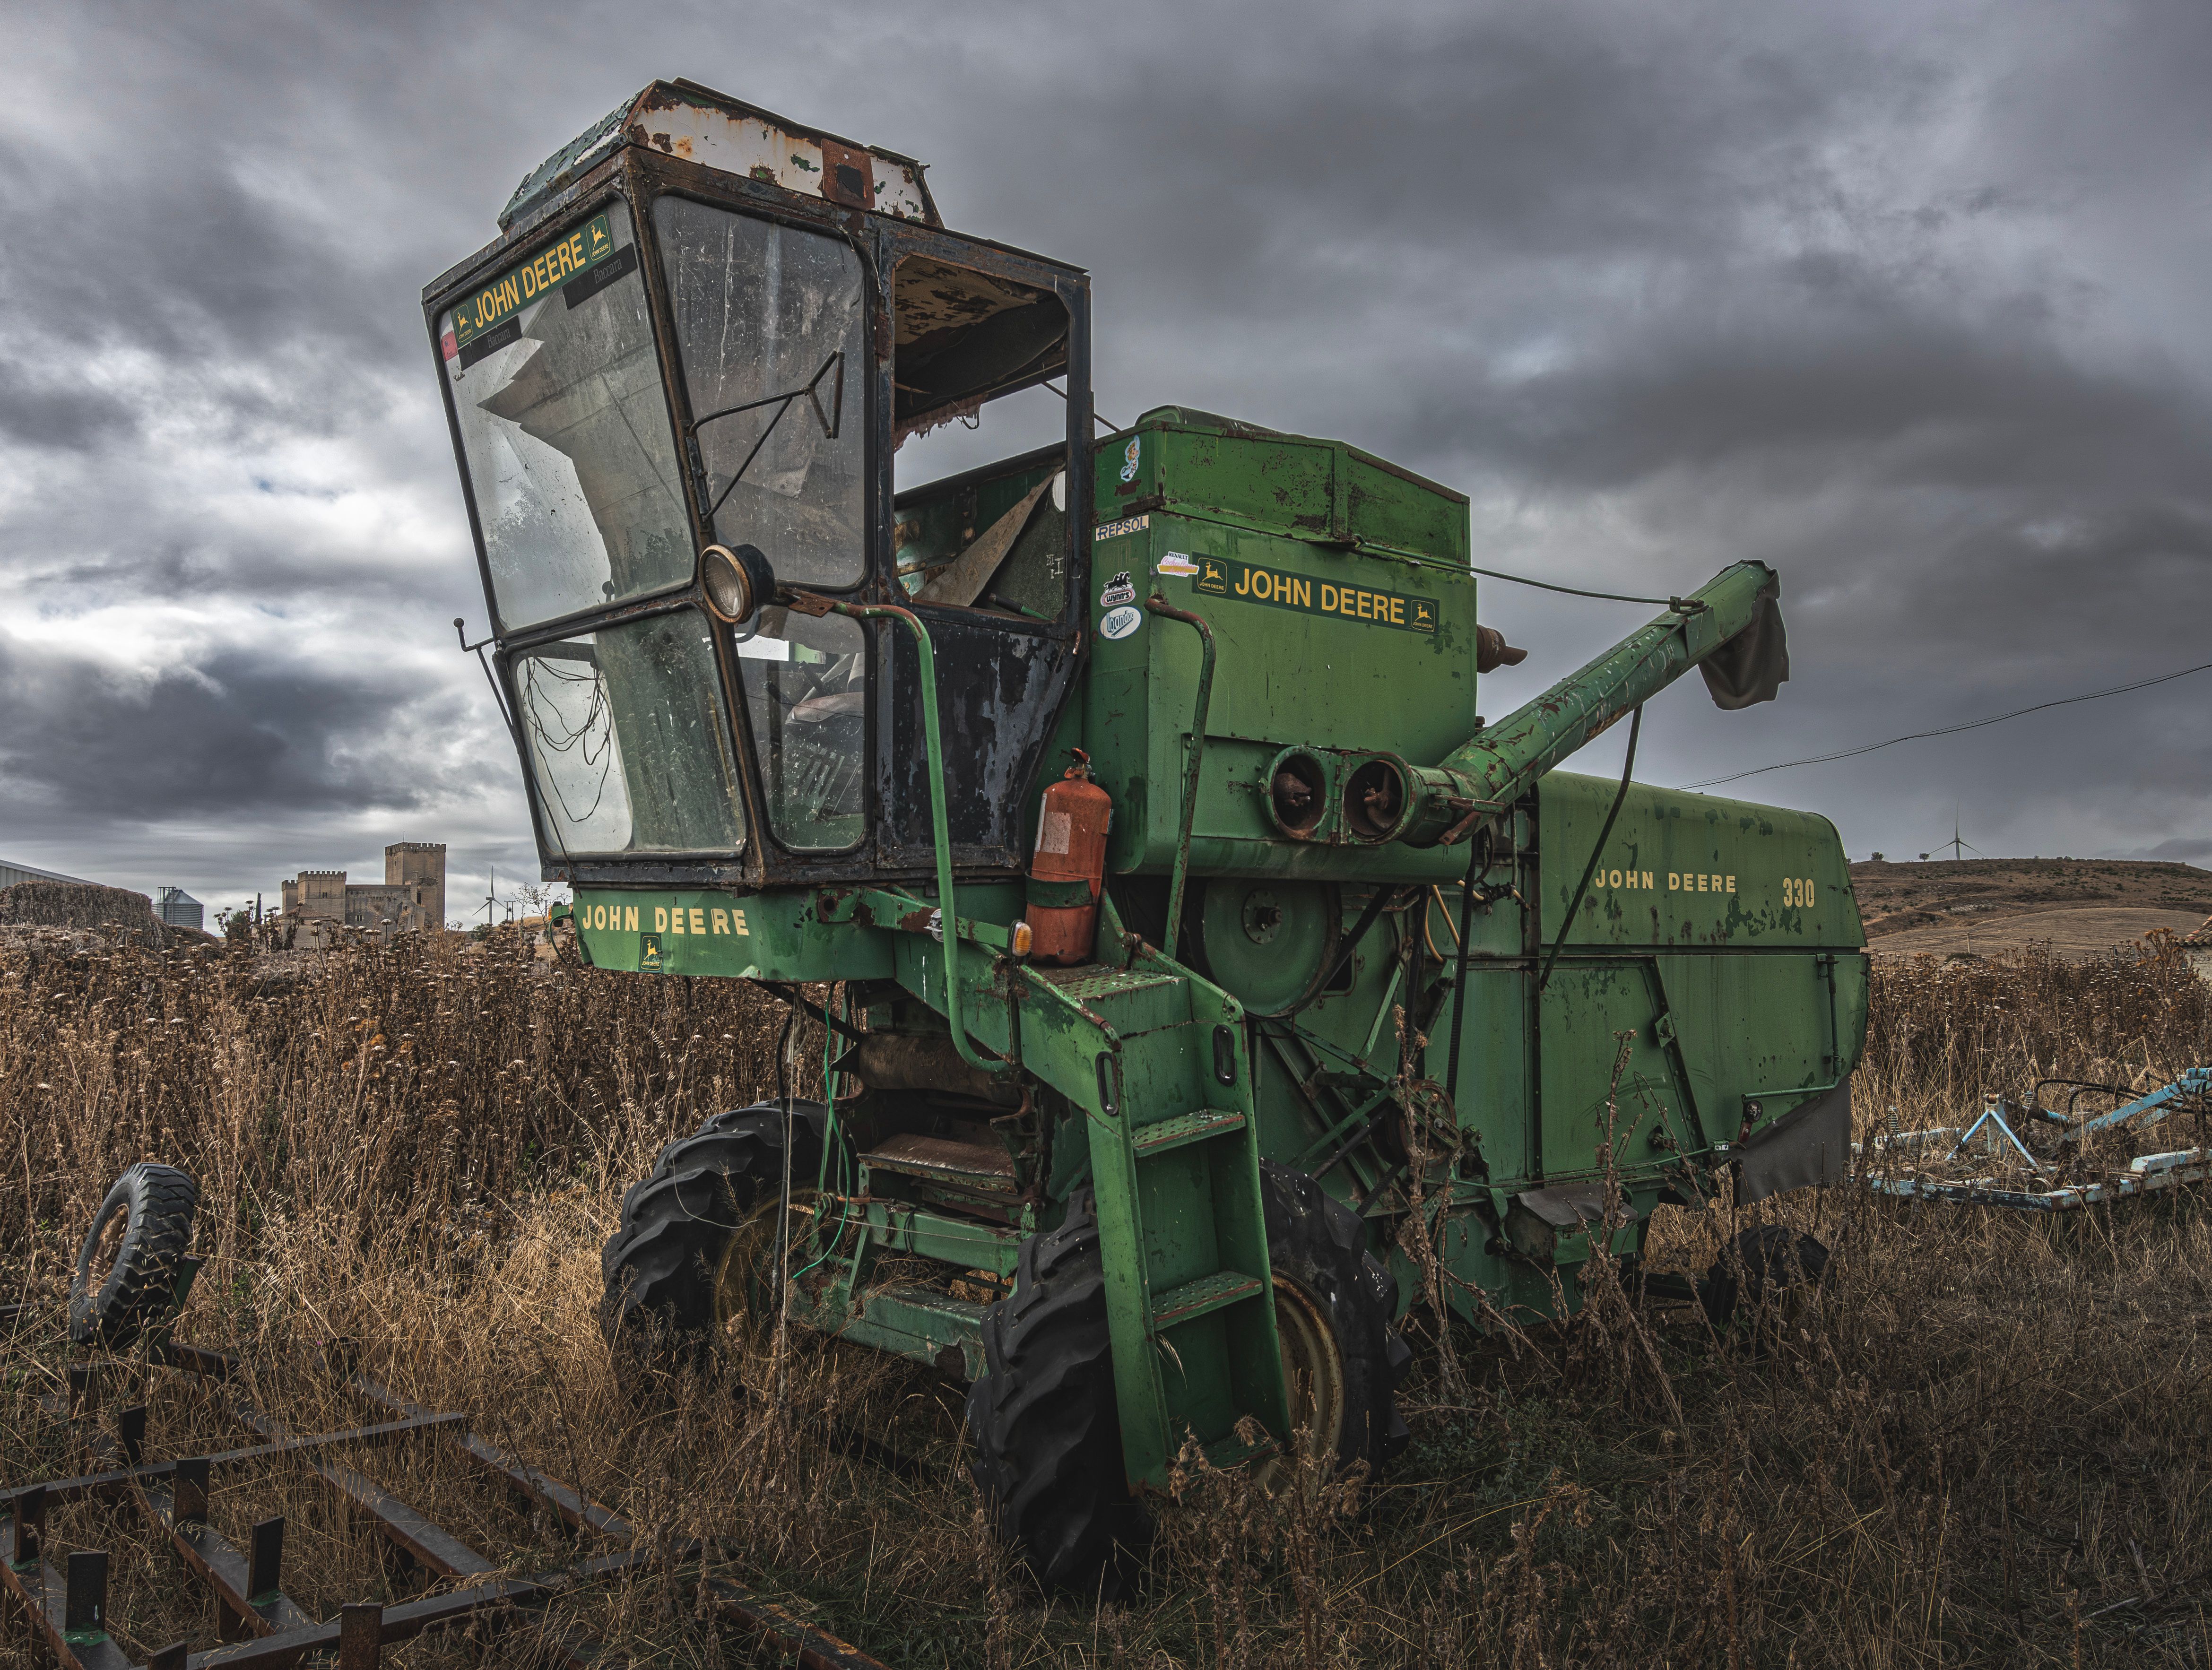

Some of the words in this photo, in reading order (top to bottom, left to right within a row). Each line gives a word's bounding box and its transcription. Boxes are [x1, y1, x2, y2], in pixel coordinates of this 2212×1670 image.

[599, 243, 609, 253] DEERE
[475, 275, 520, 328] JOHN
[521, 232, 586, 299] DEERE
[593, 259, 623, 284] Baccara
[486, 329, 511, 348] Baccara
[1097, 516, 1146, 540] REPSOL
[1169, 552, 1188, 560] RENAULT
[1235, 568, 1310, 607] JOHN
[1321, 585, 1405, 624] DEERE
[1595, 869, 1654, 889] JOHN
[1668, 872, 1736, 892] DEERE
[1783, 878, 1815, 908] 330
[582, 905, 639, 932] JOHN
[655, 907, 749, 936] DEERE
